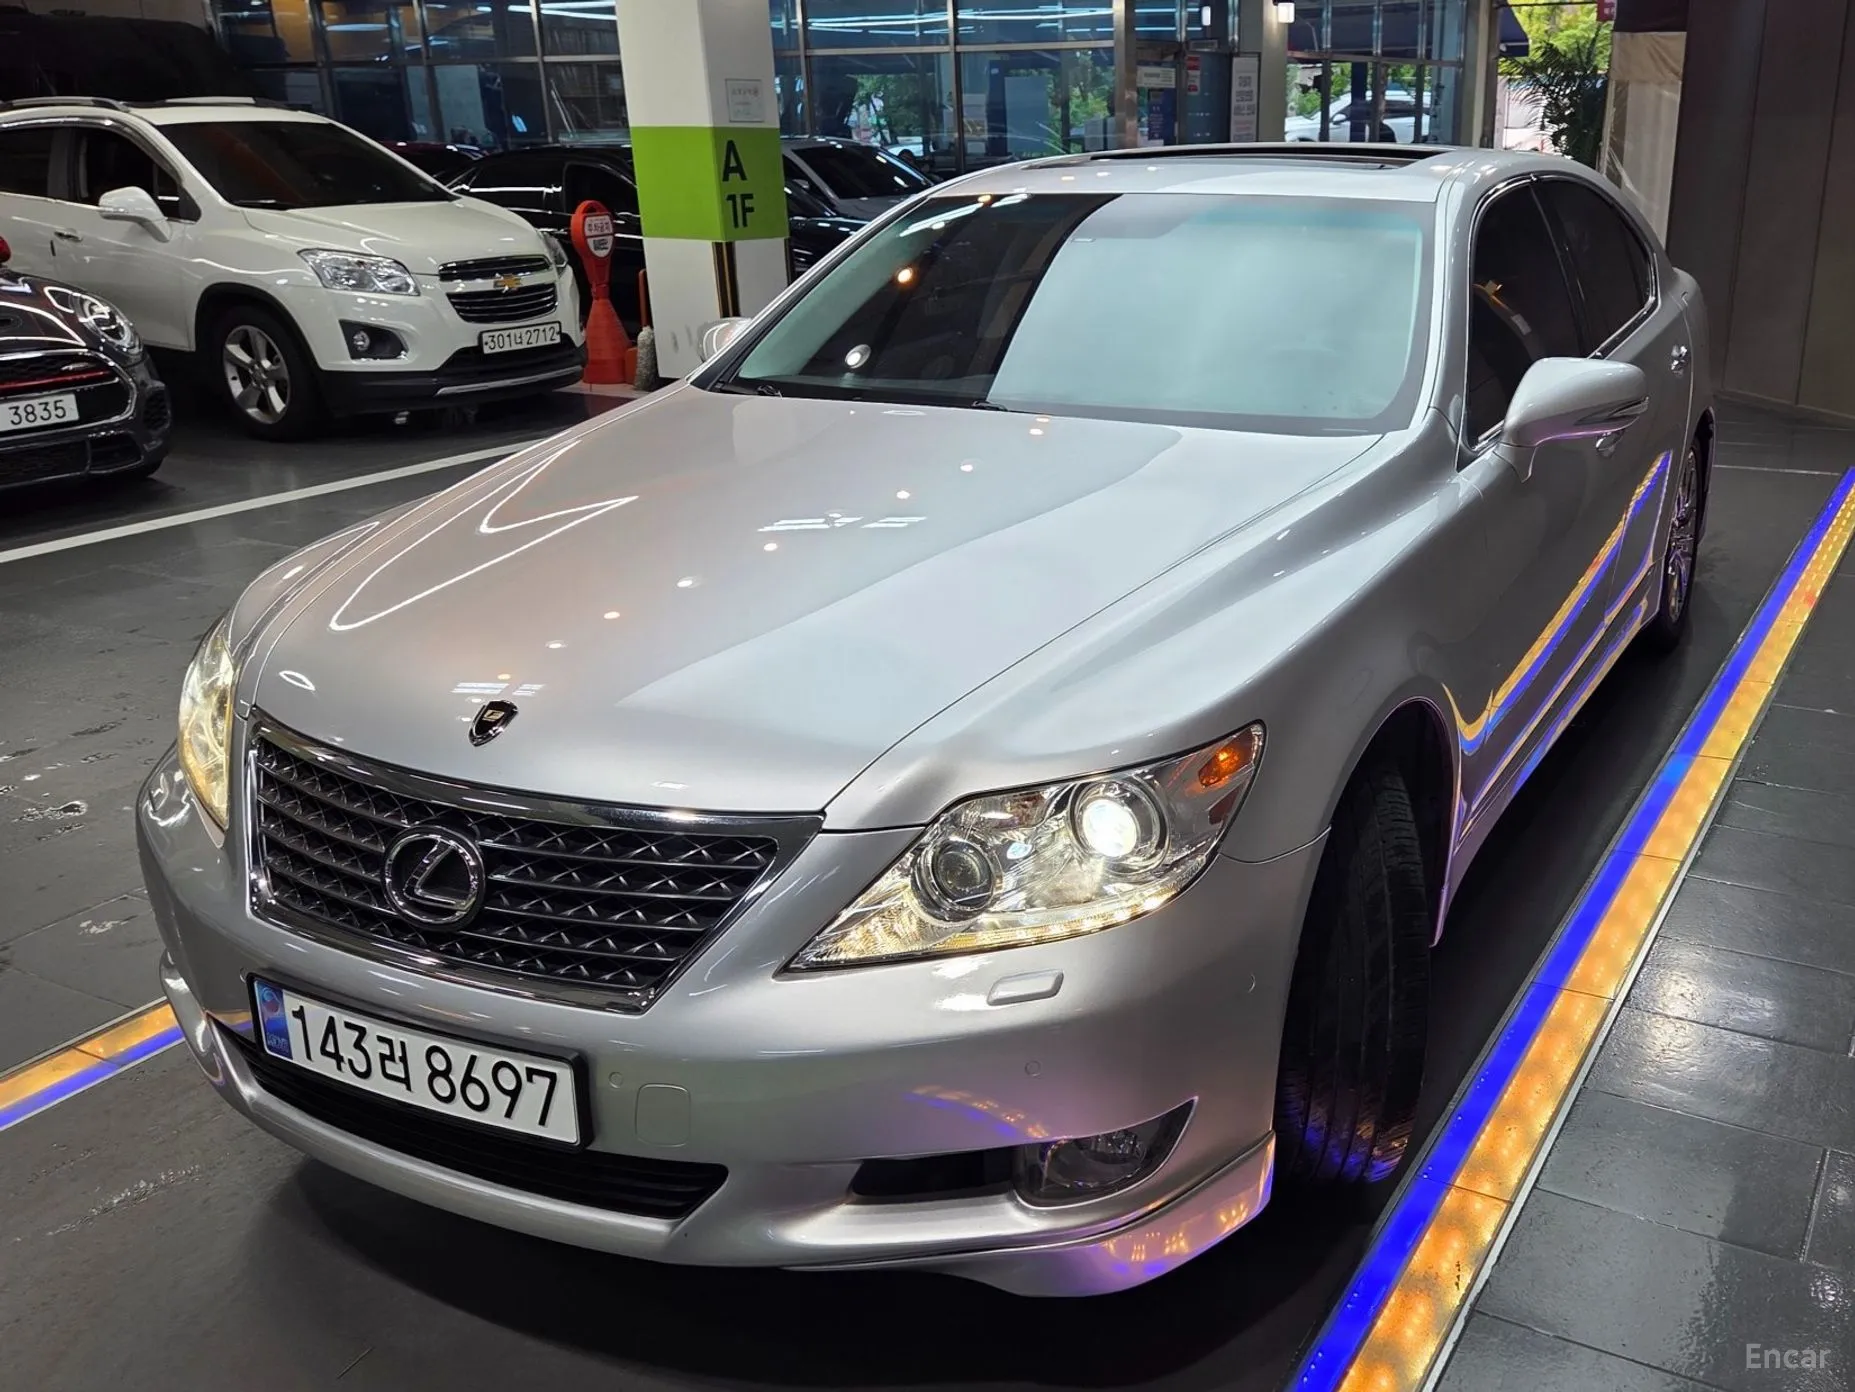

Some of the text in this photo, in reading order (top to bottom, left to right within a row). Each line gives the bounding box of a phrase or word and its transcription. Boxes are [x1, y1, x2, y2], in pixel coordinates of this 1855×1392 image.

[722, 139, 748, 182] A
[725, 193, 755, 229] 1F
[525, 326, 556, 346] 2712
[8, 399, 67, 426] 3835
[291, 1004, 558, 1127] 143러 8697
